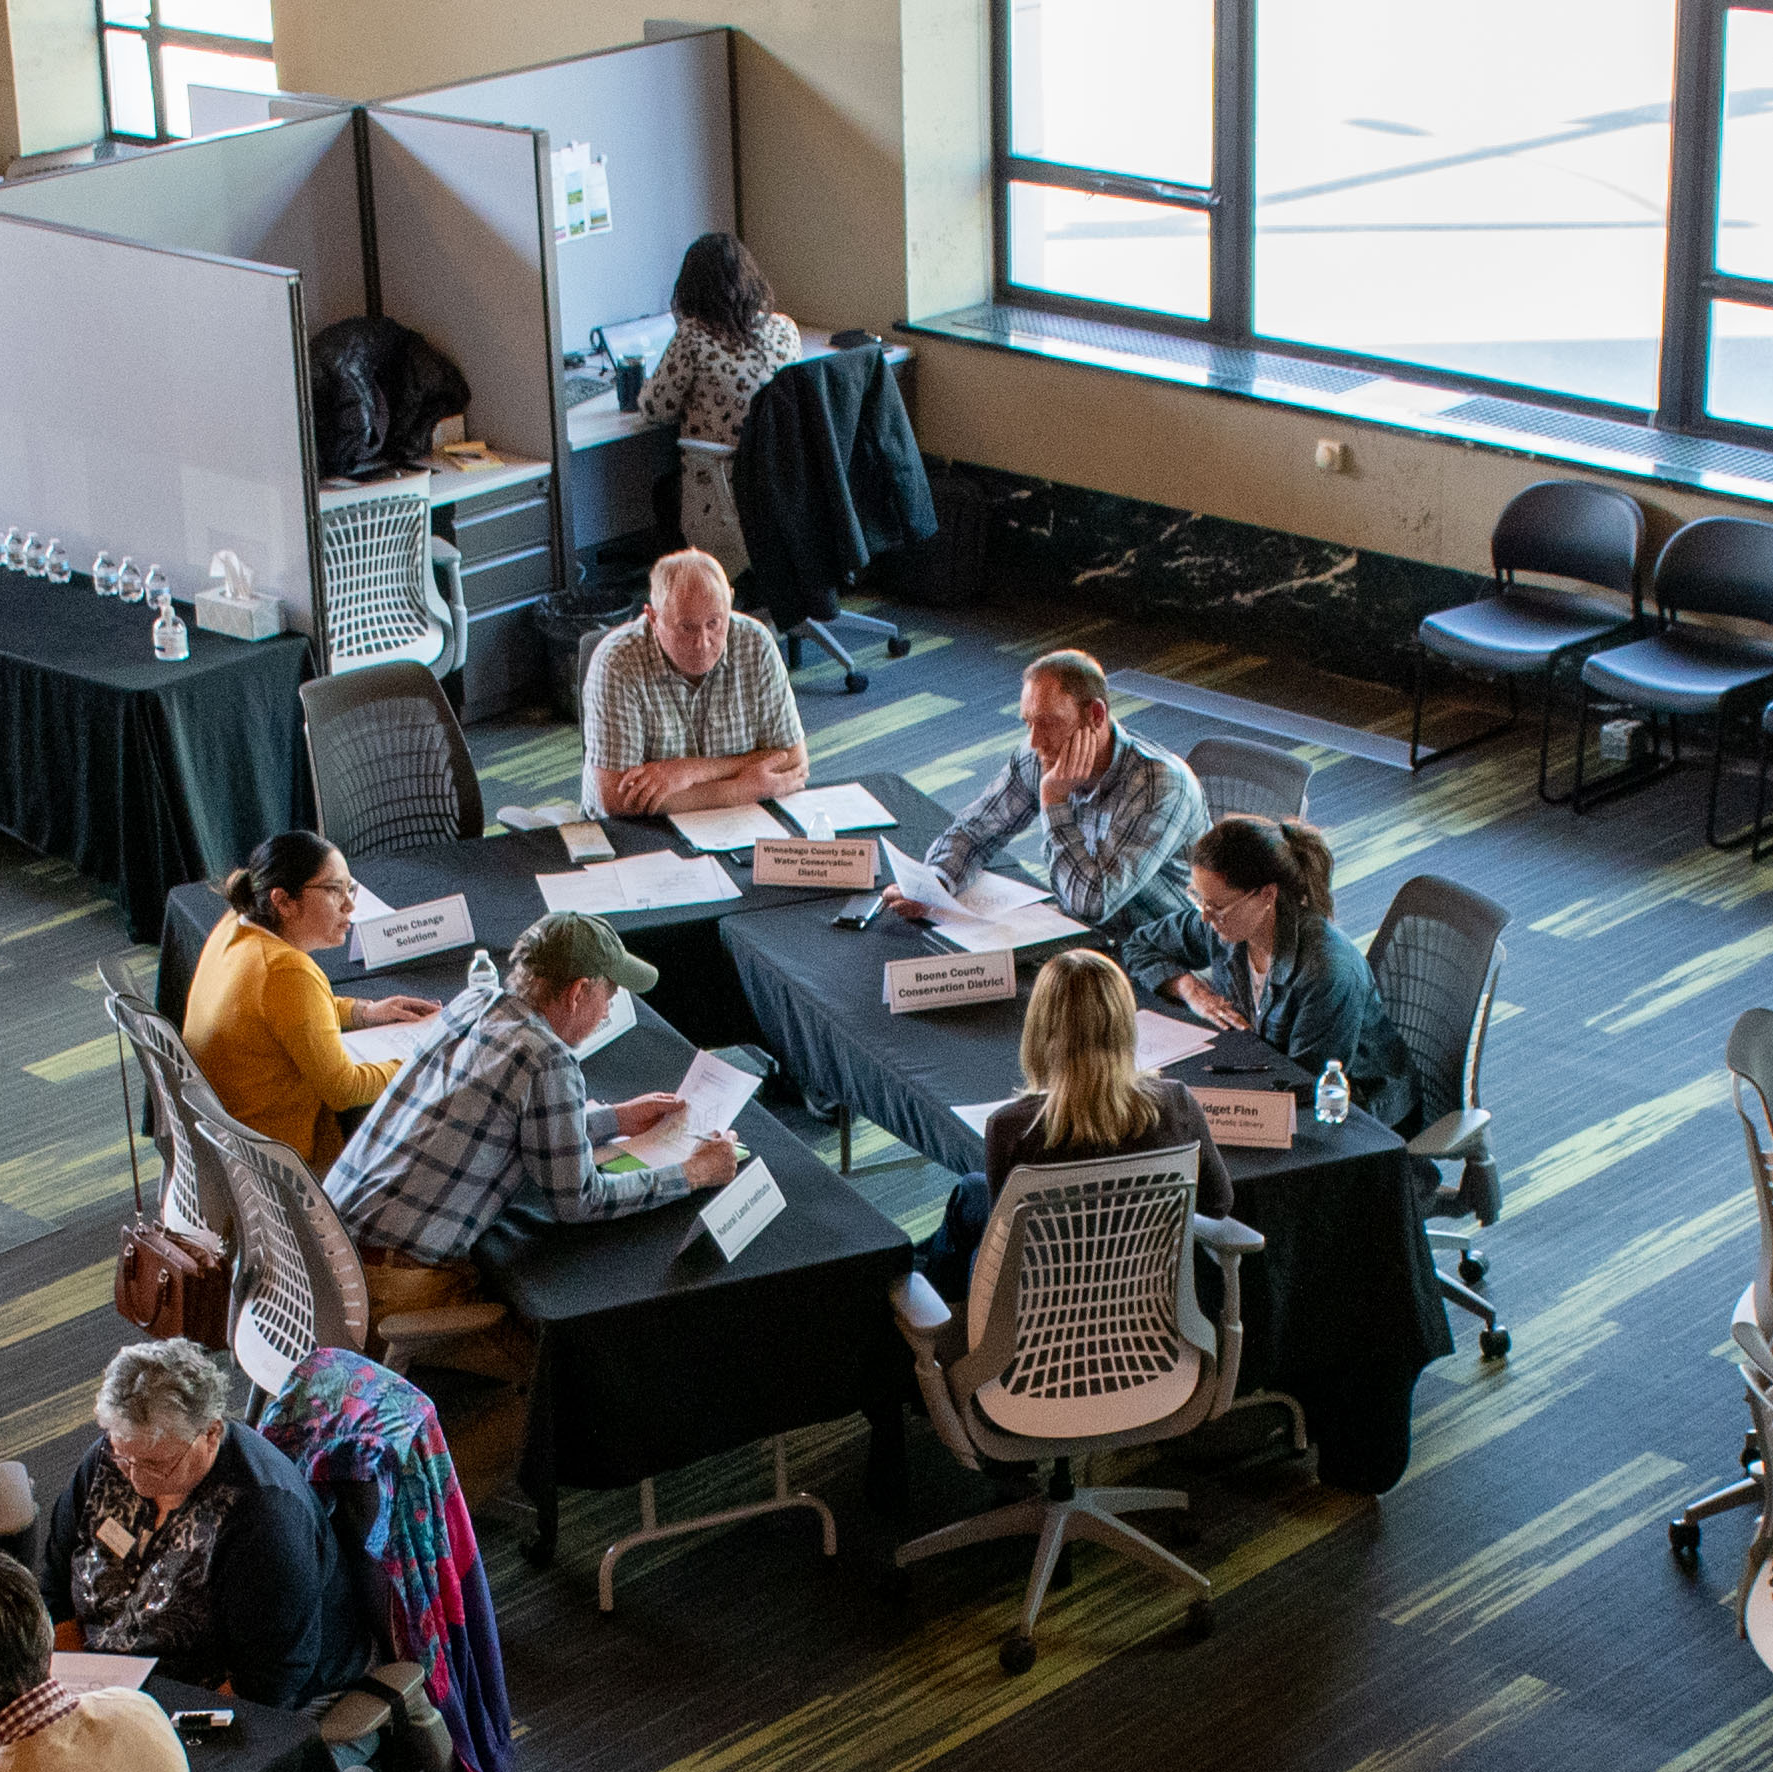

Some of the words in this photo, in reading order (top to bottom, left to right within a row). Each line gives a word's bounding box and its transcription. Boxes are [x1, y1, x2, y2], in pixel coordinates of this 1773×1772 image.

[763, 845, 808, 856] Winnebago
[810, 847, 839, 857] County
[858, 849, 865, 857] &
[773, 856, 798, 865] Water
[800, 857, 854, 867] Conservation
[797, 868, 828, 878] District
[382, 923, 410, 938] Ignite
[410, 914, 445, 930] Change
[396, 930, 438, 947] Solutions
[915, 970, 948, 982] Boone
[950, 965, 986, 978] County
[898, 983, 965, 998] Conservation
[968, 977, 1005, 990] District
[1234, 1104, 1259, 1116] Finn
